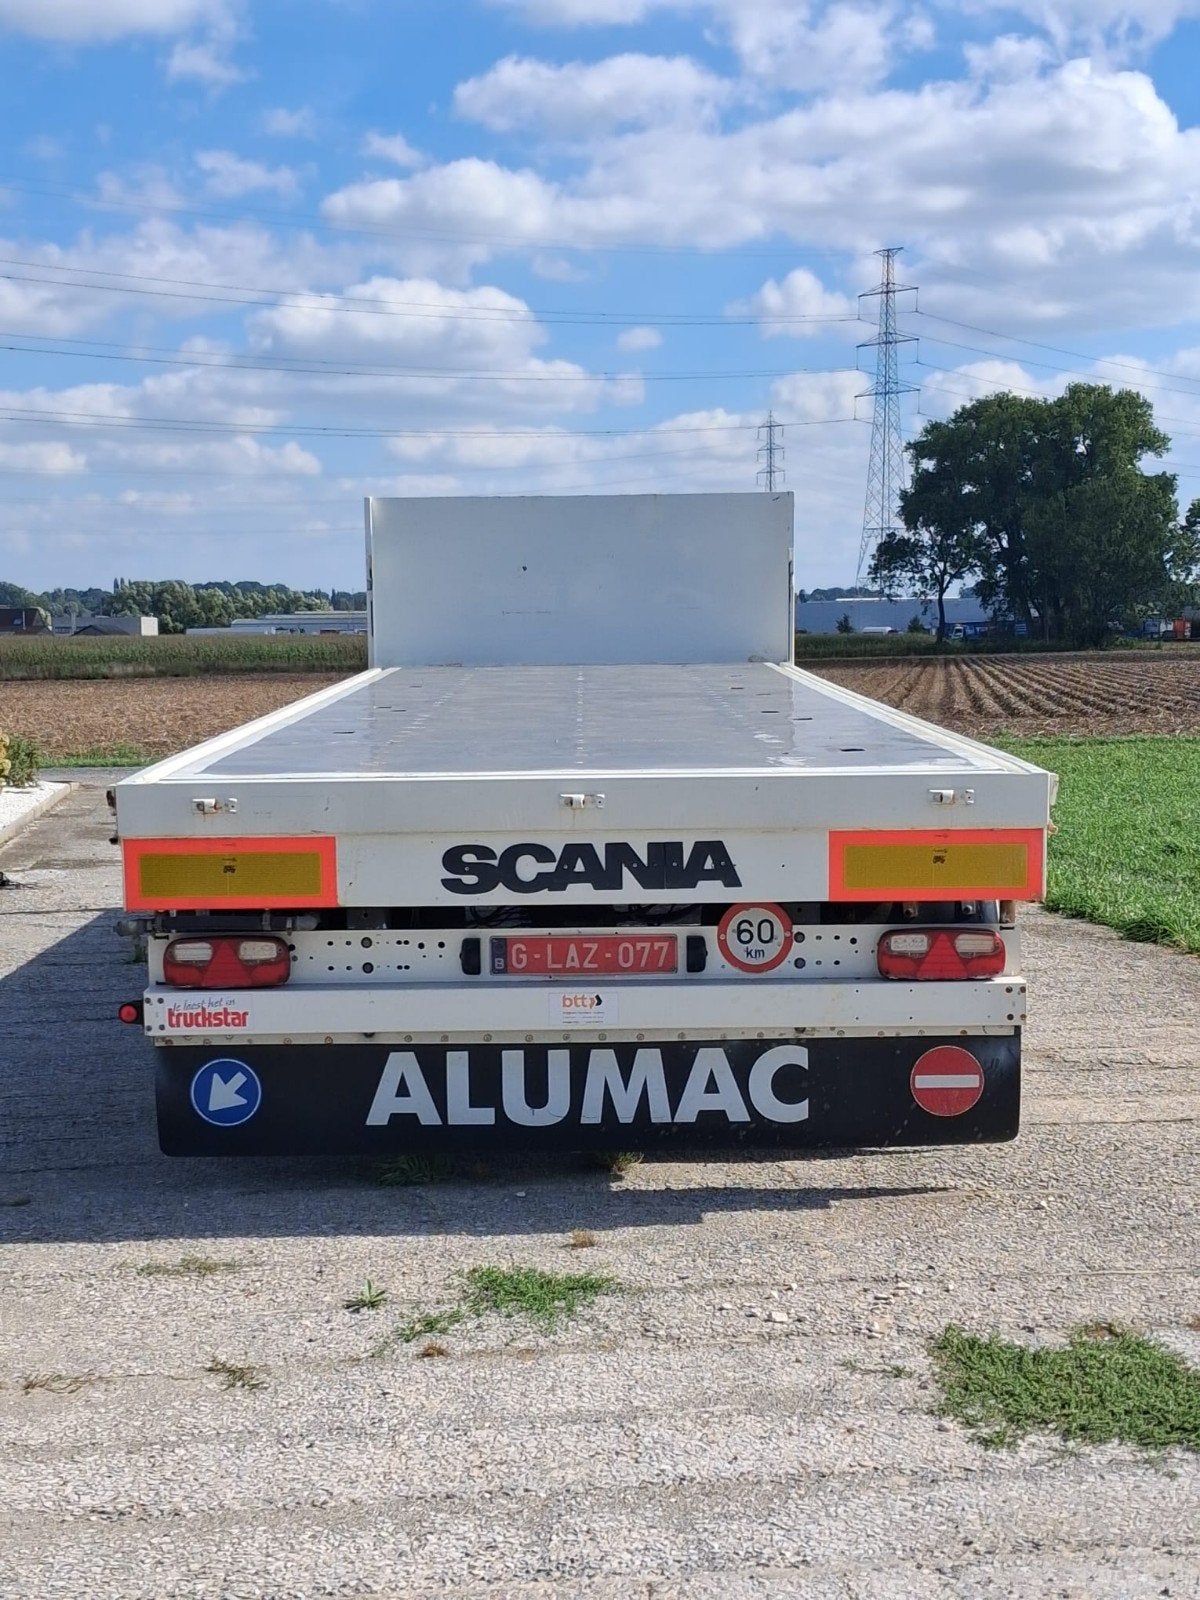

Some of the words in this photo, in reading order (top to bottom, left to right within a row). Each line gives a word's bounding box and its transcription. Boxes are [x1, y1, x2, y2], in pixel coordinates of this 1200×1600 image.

[440, 840, 743, 895] SCANIA
[736, 918, 775, 945] 60
[745, 946, 765, 959] km
[167, 1007, 249, 1029] truckstar
[365, 1044, 810, 1126] ALUMAC
